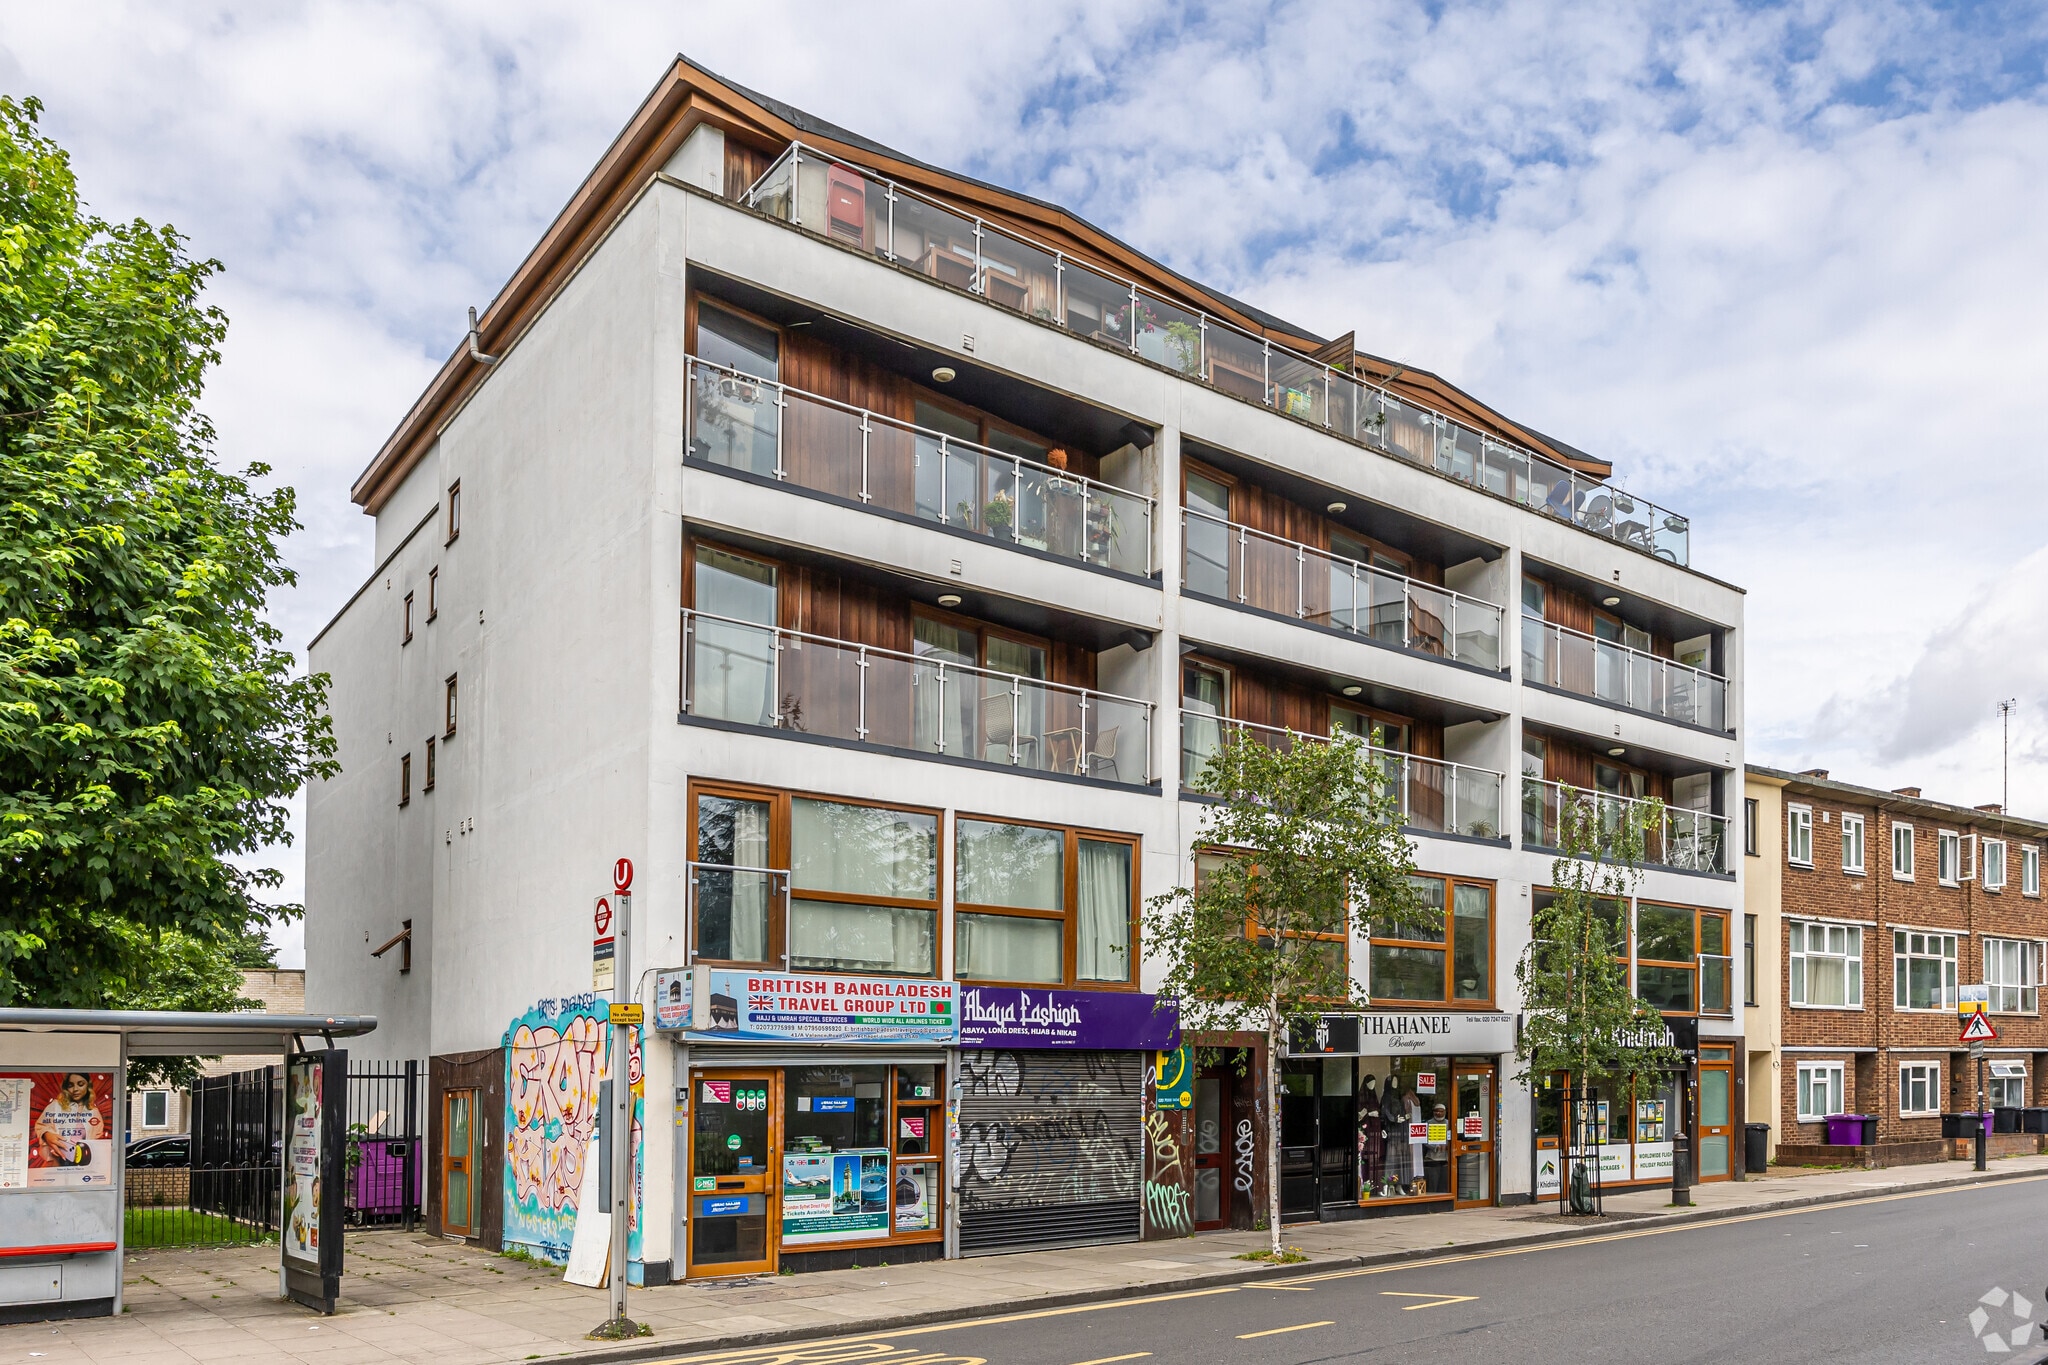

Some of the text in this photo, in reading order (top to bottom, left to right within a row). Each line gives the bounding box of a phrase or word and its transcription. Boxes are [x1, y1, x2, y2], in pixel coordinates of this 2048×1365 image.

[748, 978, 952, 998] BRITISH BANGLADESH
[778, 997, 926, 1014] TRAVEL GROUP LTD
[963, 988, 1017, 1029] Abaya
[1020, 990, 1082, 1027] Fashion
[620, 1012, 641, 1020] stopping
[756, 1014, 771, 1022] HAJJ
[1363, 1016, 1451, 1035] THAHANEE
[961, 1027, 988, 1035] ABAYA,
[1008, 1028, 1030, 1036] DRESS,
[1031, 1028, 1050, 1036] HIJAB
[1388, 1035, 1426, 1051] Boutique
[1419, 1076, 1435, 1085] SALE
[61, 1129, 83, 1137] £5.25
[1410, 1126, 1427, 1135] SALE
